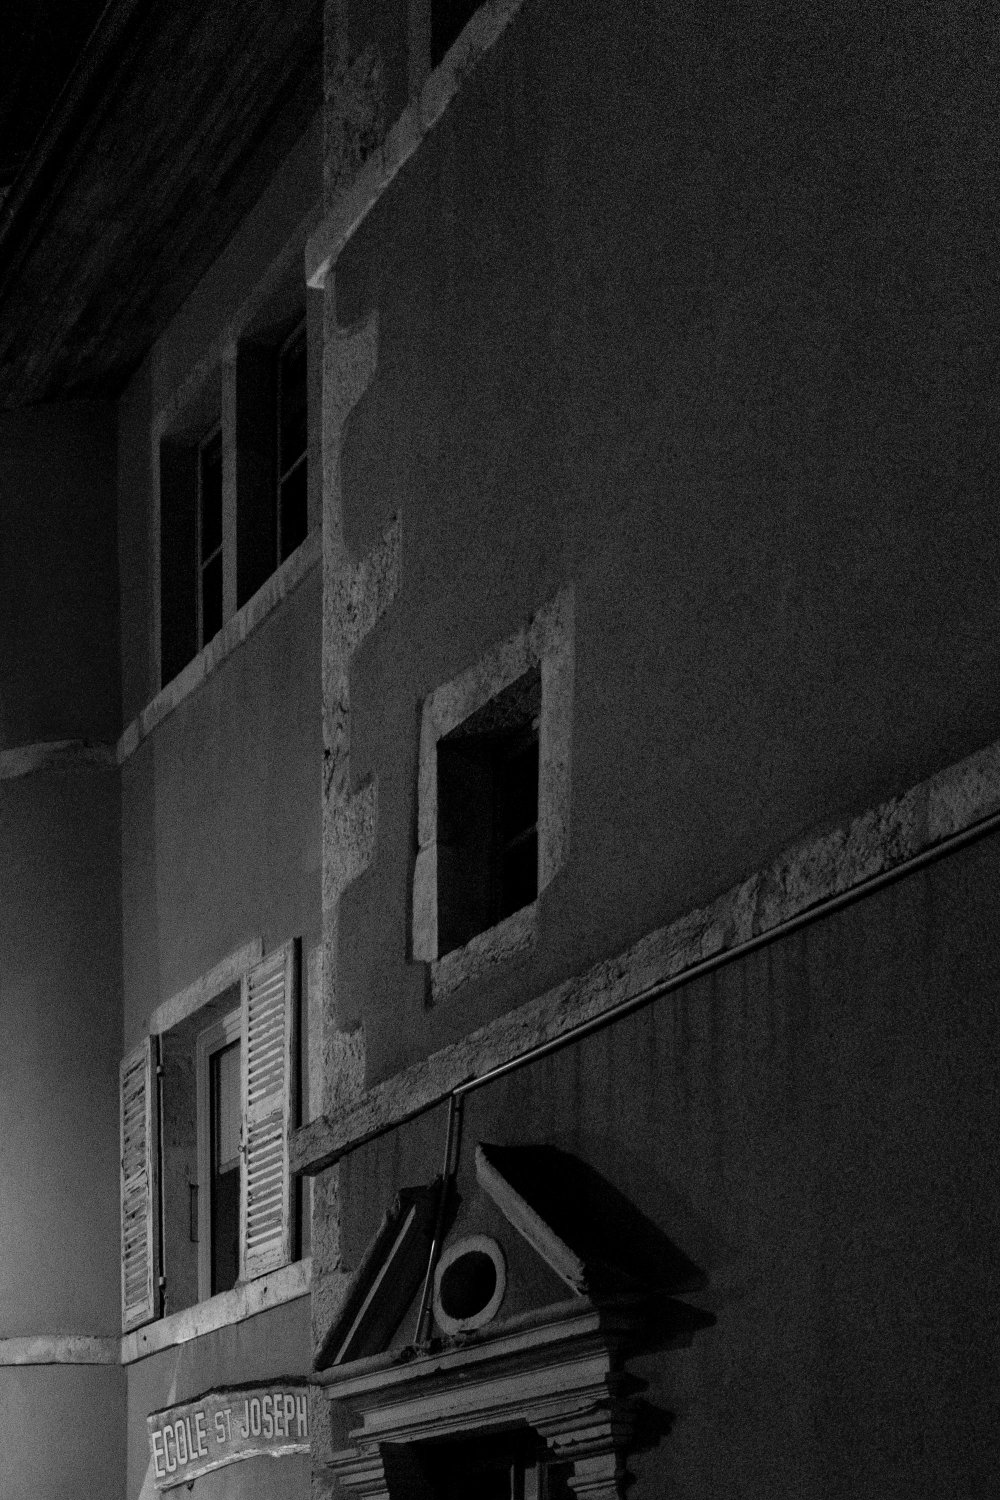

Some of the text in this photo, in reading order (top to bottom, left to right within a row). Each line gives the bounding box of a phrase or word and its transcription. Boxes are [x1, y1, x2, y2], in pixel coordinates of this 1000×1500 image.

[152, 1393, 309, 1478] ECOLE ST JOSEPH
